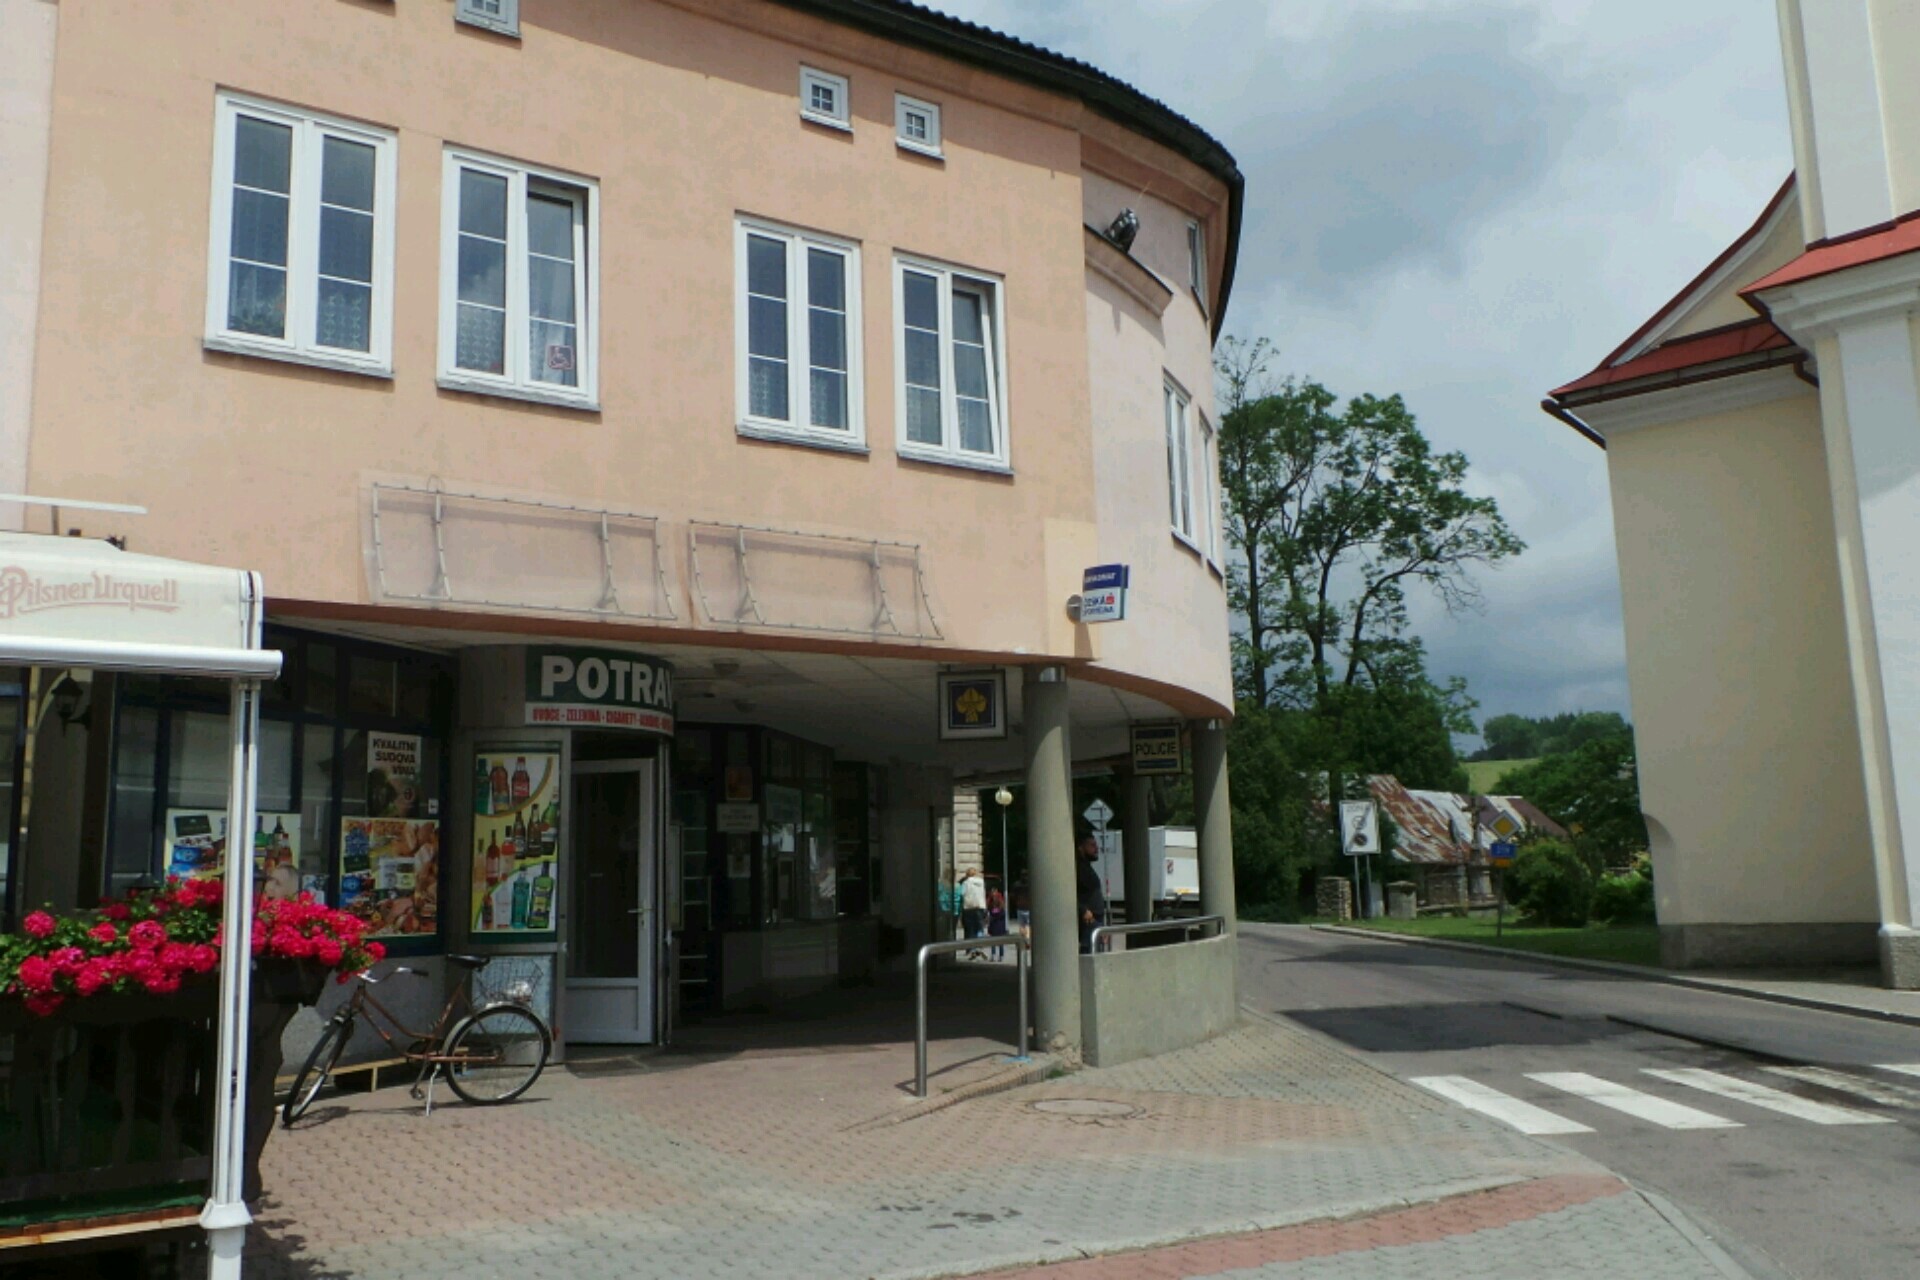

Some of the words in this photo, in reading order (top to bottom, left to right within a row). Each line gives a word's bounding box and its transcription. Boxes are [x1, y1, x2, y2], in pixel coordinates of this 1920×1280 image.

[0, 565, 93, 618] Pilsner
[91, 571, 178, 611] Urquell
[566, 708, 601, 722] ZELENINA
[1135, 741, 1176, 755] POLICIE
